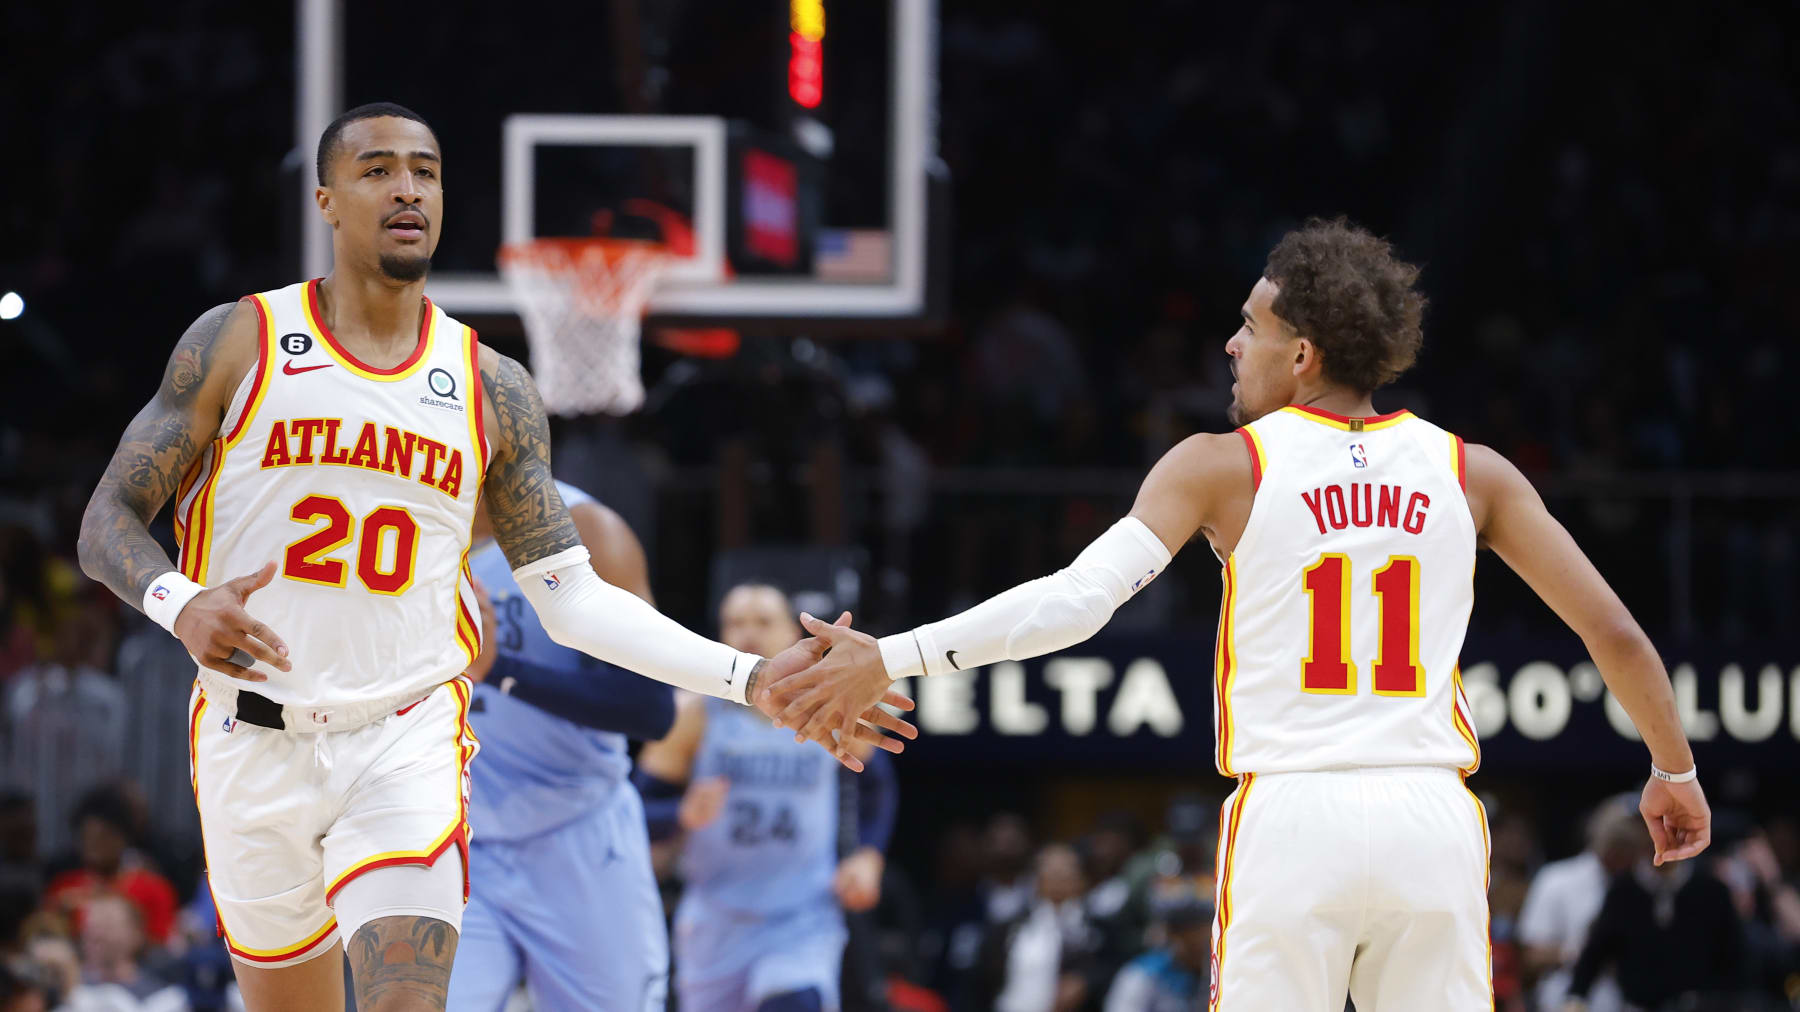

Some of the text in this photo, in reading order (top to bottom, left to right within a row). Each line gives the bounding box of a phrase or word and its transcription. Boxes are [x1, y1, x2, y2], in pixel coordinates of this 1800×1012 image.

[288, 336, 305, 353] 6
[420, 396, 464, 412] sharecare
[261, 418, 464, 500] ATLANTA
[1301, 483, 1431, 535] YOUNG
[282, 494, 421, 596] 20
[1300, 552, 1427, 698] 11
[877, 657, 1184, 738] ELTA
[1604, 662, 1800, 743] LU
[728, 797, 799, 847] 24
